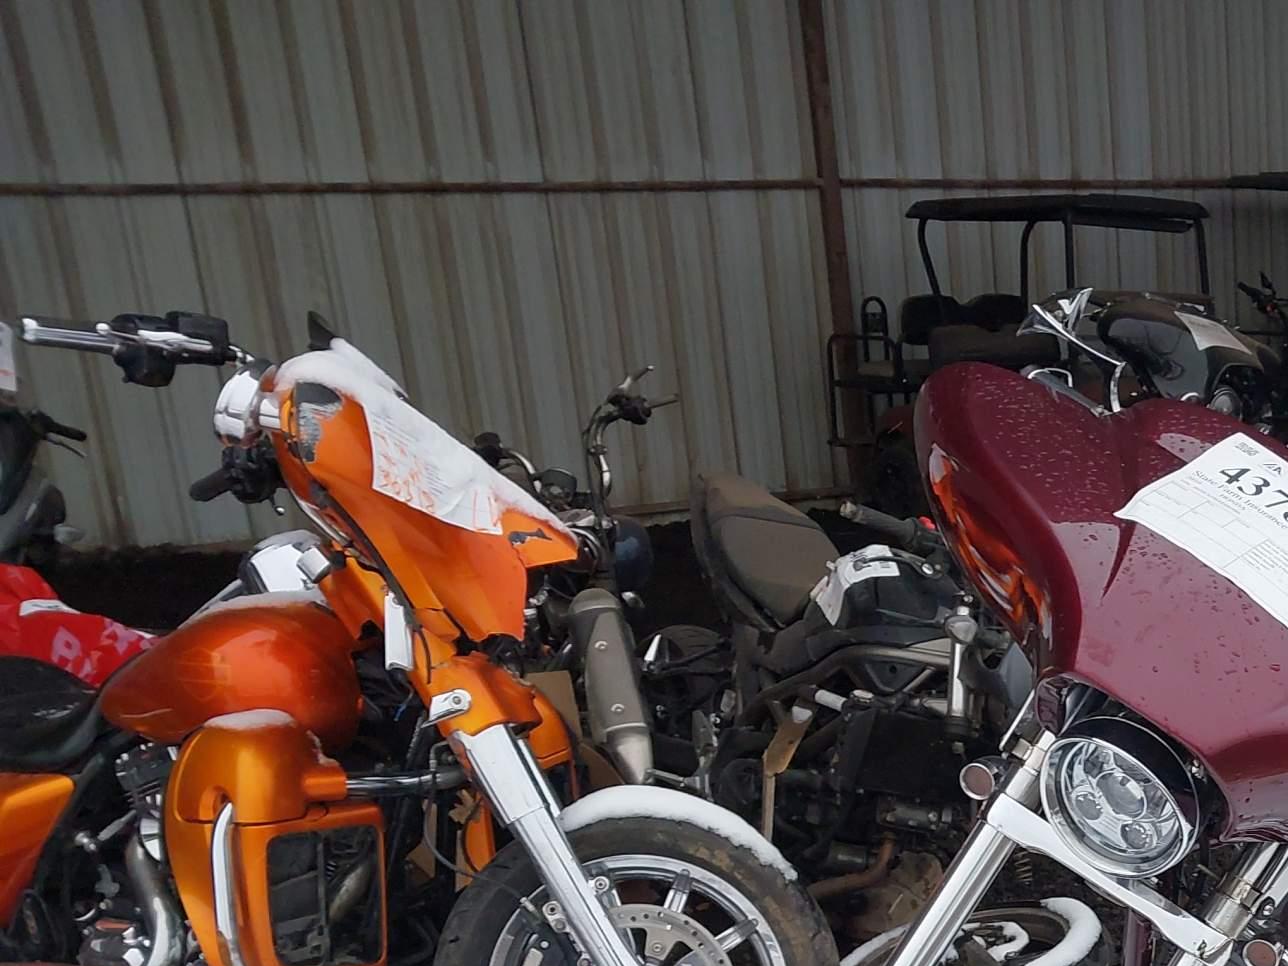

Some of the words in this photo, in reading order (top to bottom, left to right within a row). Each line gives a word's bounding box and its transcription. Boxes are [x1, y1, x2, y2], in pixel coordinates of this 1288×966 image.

[1192, 470, 1217, 485] State
[1217, 484, 1243, 501] Farm
[1244, 499, 1288, 529] Insurance
